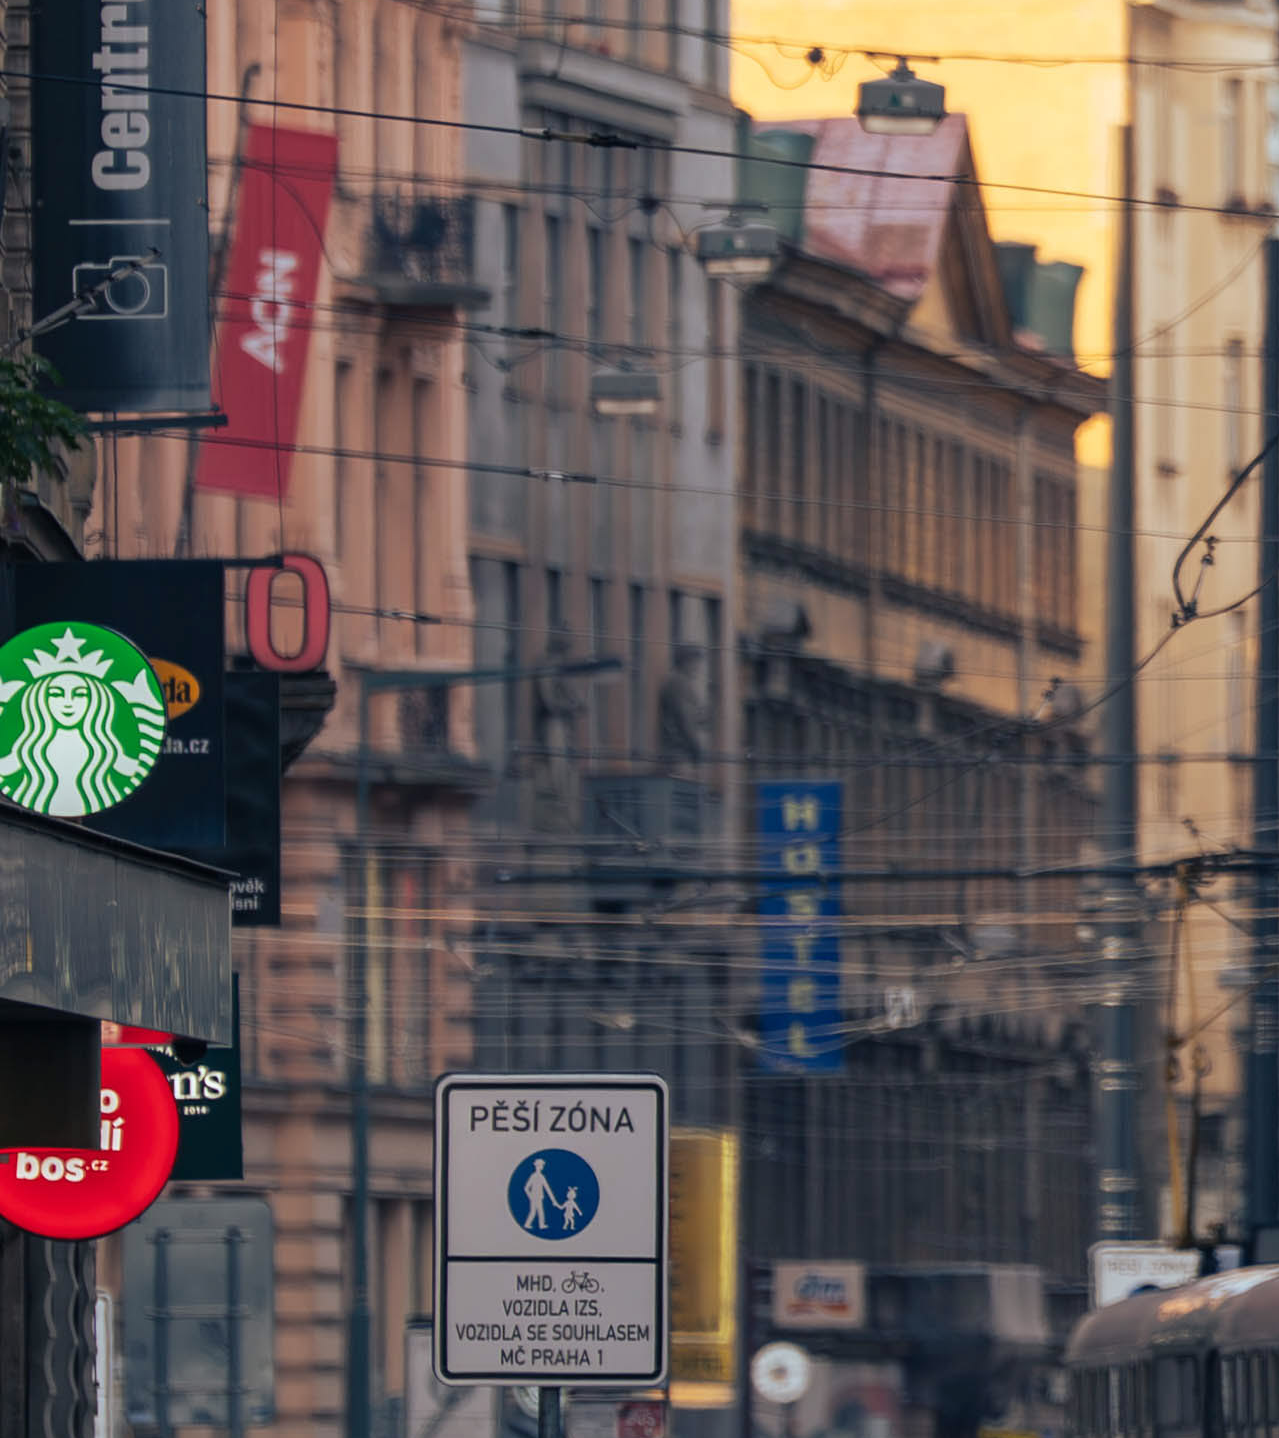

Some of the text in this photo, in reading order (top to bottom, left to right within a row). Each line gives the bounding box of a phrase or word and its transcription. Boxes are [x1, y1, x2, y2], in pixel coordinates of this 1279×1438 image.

[470, 1100, 635, 1133] PĚŠÍ ZÓNA
[502, 1299, 569, 1317] VOZIDLA
[456, 1324, 650, 1341] VOZIDLA SE SOUHLASEM
[500, 1346, 604, 1366] MČ PRAHA 1
